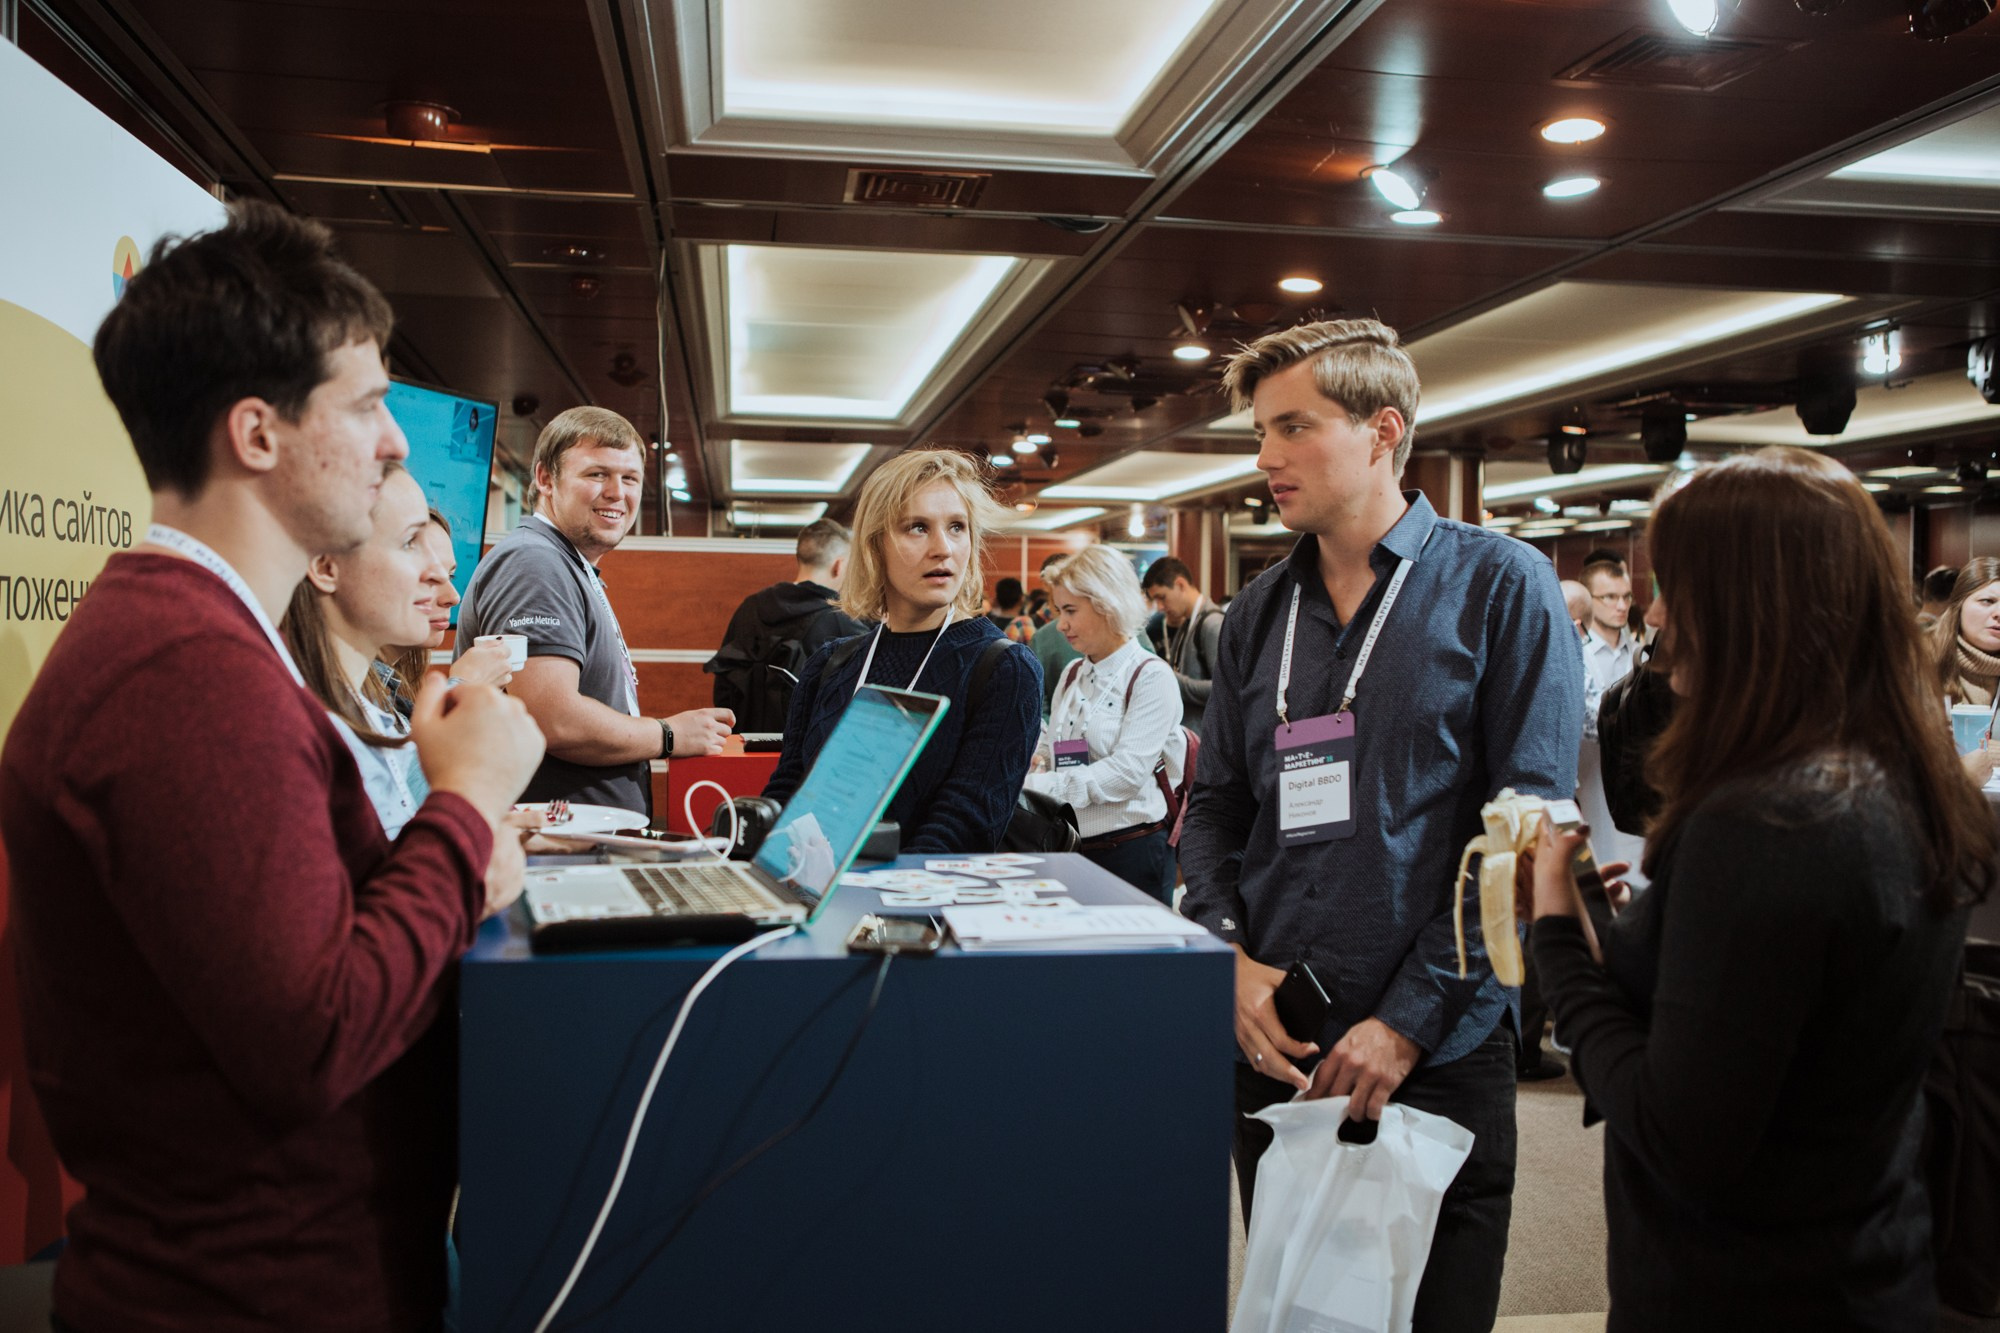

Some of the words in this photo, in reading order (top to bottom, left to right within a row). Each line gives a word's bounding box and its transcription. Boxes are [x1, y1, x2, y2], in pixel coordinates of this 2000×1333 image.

[52, 490, 132, 549] сайтов
[508, 616, 534, 628] Yandex
[534, 615, 561, 626] Metrica
[1288, 777, 1315, 791] Digital
[1317, 774, 1342, 786] BBDO
